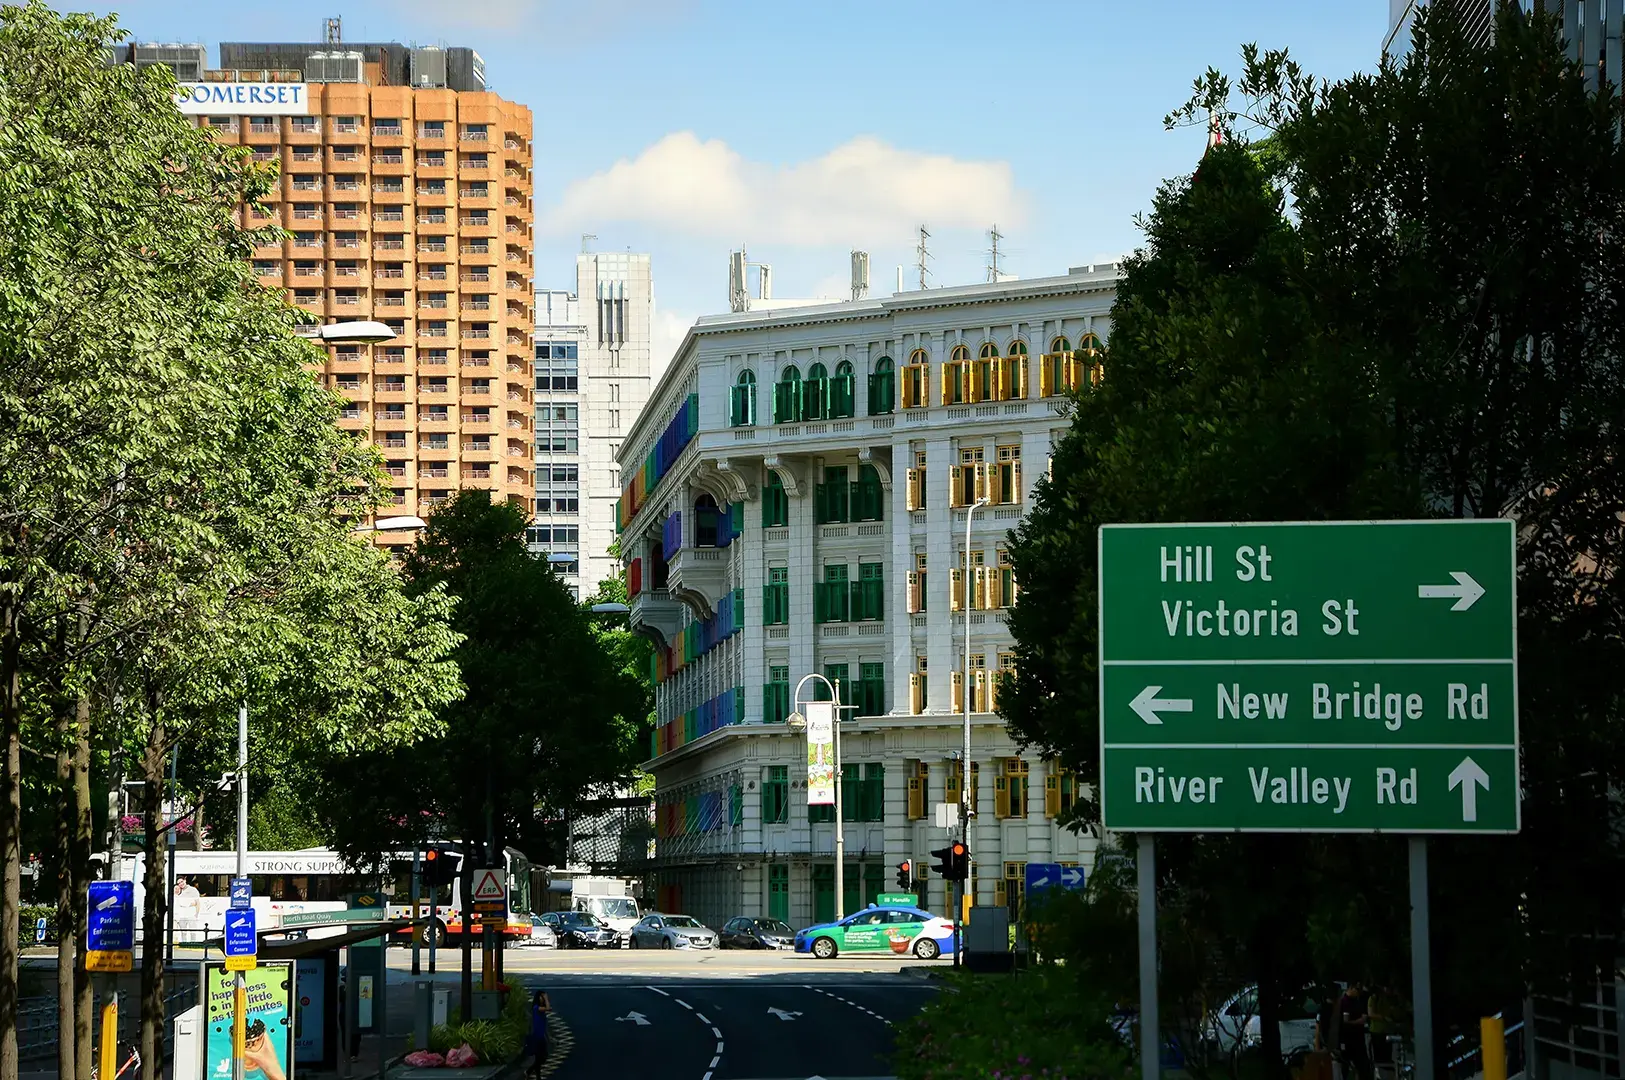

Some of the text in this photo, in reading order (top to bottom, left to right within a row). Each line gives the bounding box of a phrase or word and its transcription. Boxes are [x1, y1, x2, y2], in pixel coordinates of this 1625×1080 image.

[1160, 545, 1272, 582] Hill St
[1161, 599, 1359, 637] Victoria St
[1217, 681, 1488, 731] New Bridge Rd
[1135, 766, 1417, 814] River Valley Rd
[254, 861, 302, 872] STRONG
[306, 861, 346, 872] SUPPO
[100, 917, 121, 925] Parking
[284, 915, 301, 923] North
[302, 914, 315, 922] Boat
[316, 913, 332, 921] Quay
[93, 928, 128, 937] Enforcement
[221, 1001, 232, 1010] in
[248, 991, 273, 1005] little
[212, 1013, 225, 1023] as
